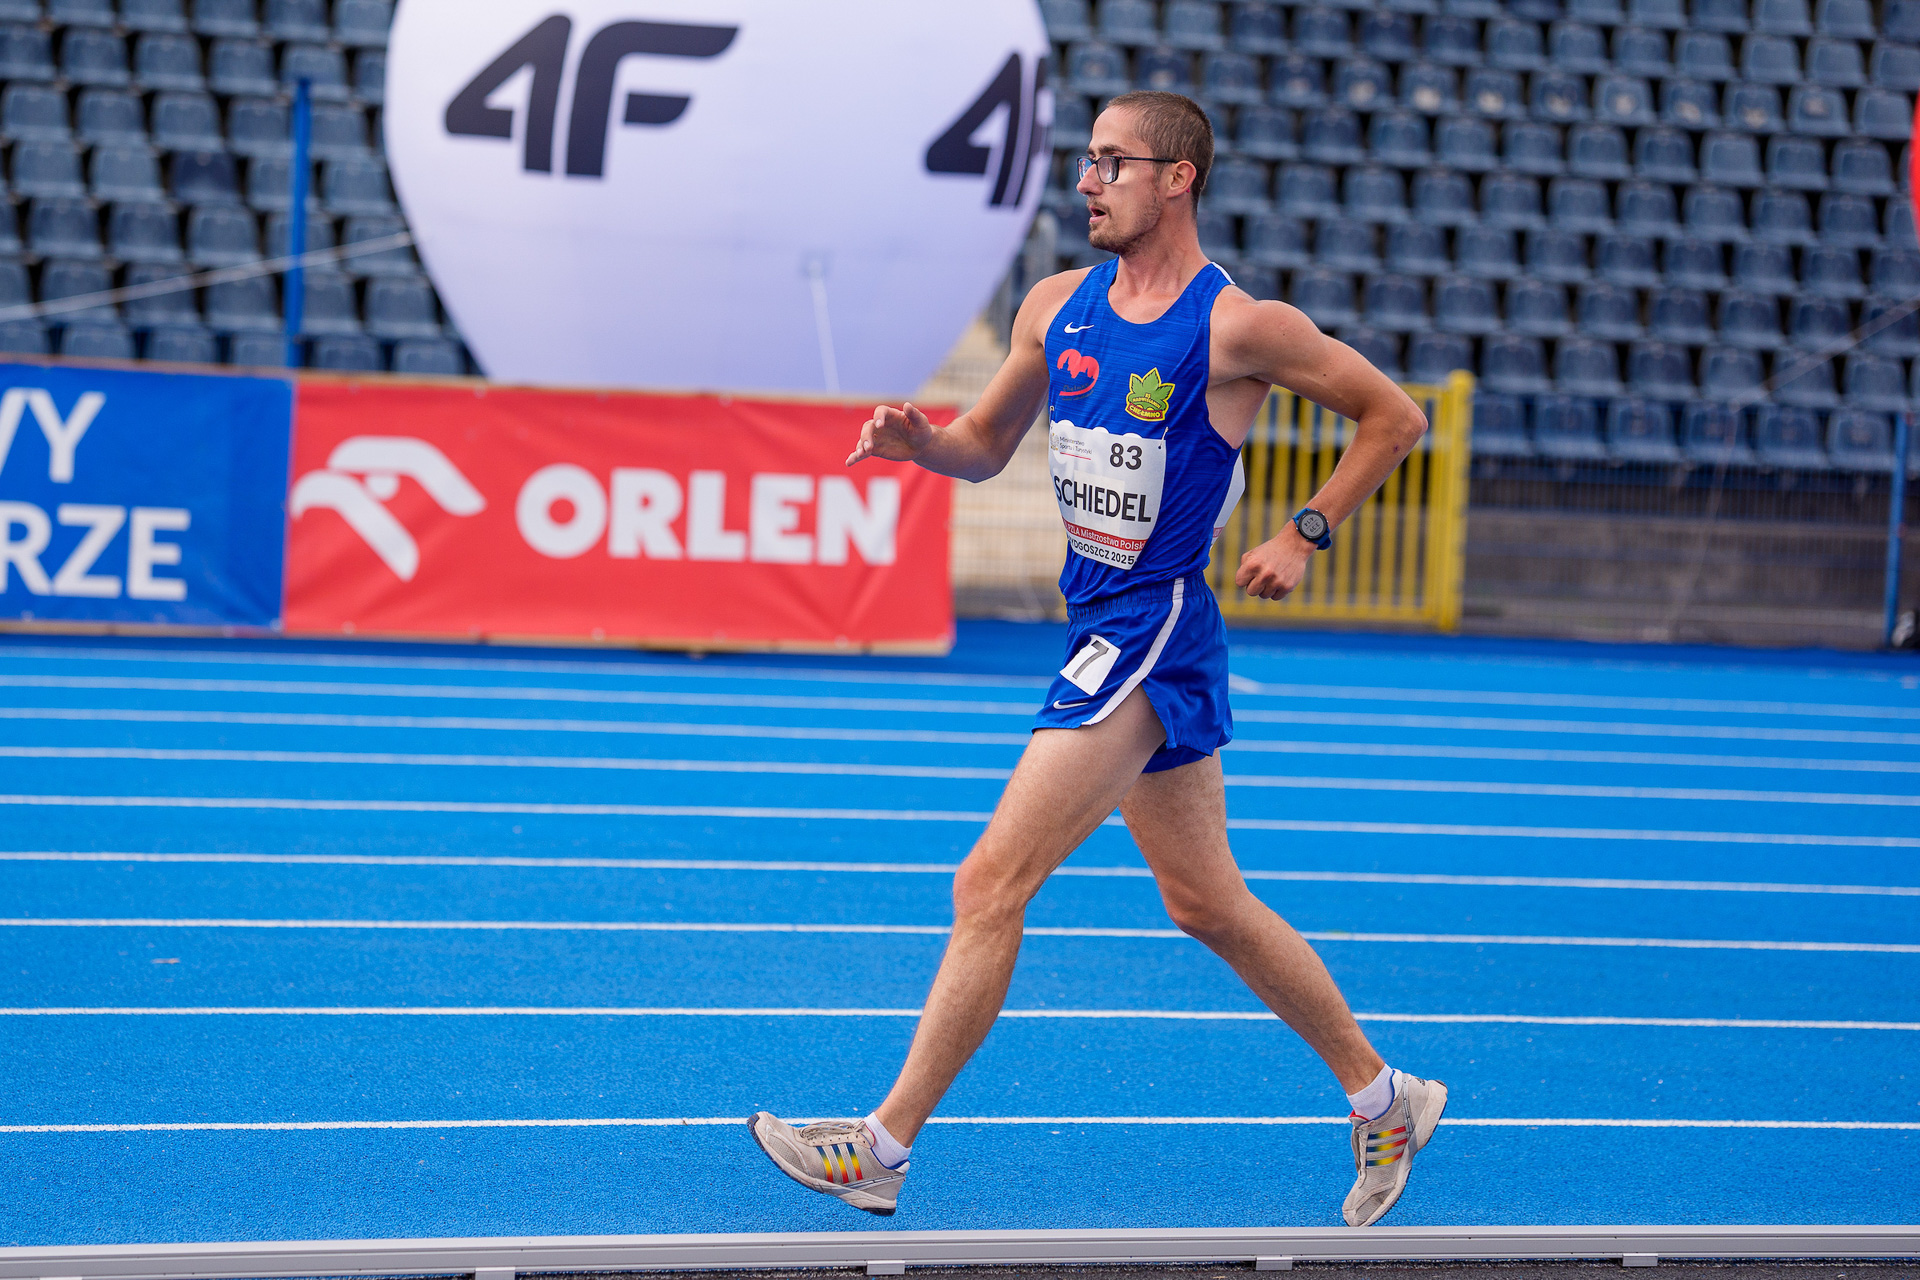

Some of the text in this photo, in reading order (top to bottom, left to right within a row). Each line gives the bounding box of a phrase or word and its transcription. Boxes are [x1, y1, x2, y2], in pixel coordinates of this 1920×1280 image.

[444, 14, 739, 178] 4F
[1109, 442, 1143, 470] 83
[515, 463, 900, 566] ORLEN
[1053, 475, 1152, 522] SCHIEDEL
[0, 500, 191, 602] RZE
[1081, 529, 1119, 546] Mistrzostwa
[1111, 551, 1135, 565] 2025
[1072, 640, 1109, 680] 7
